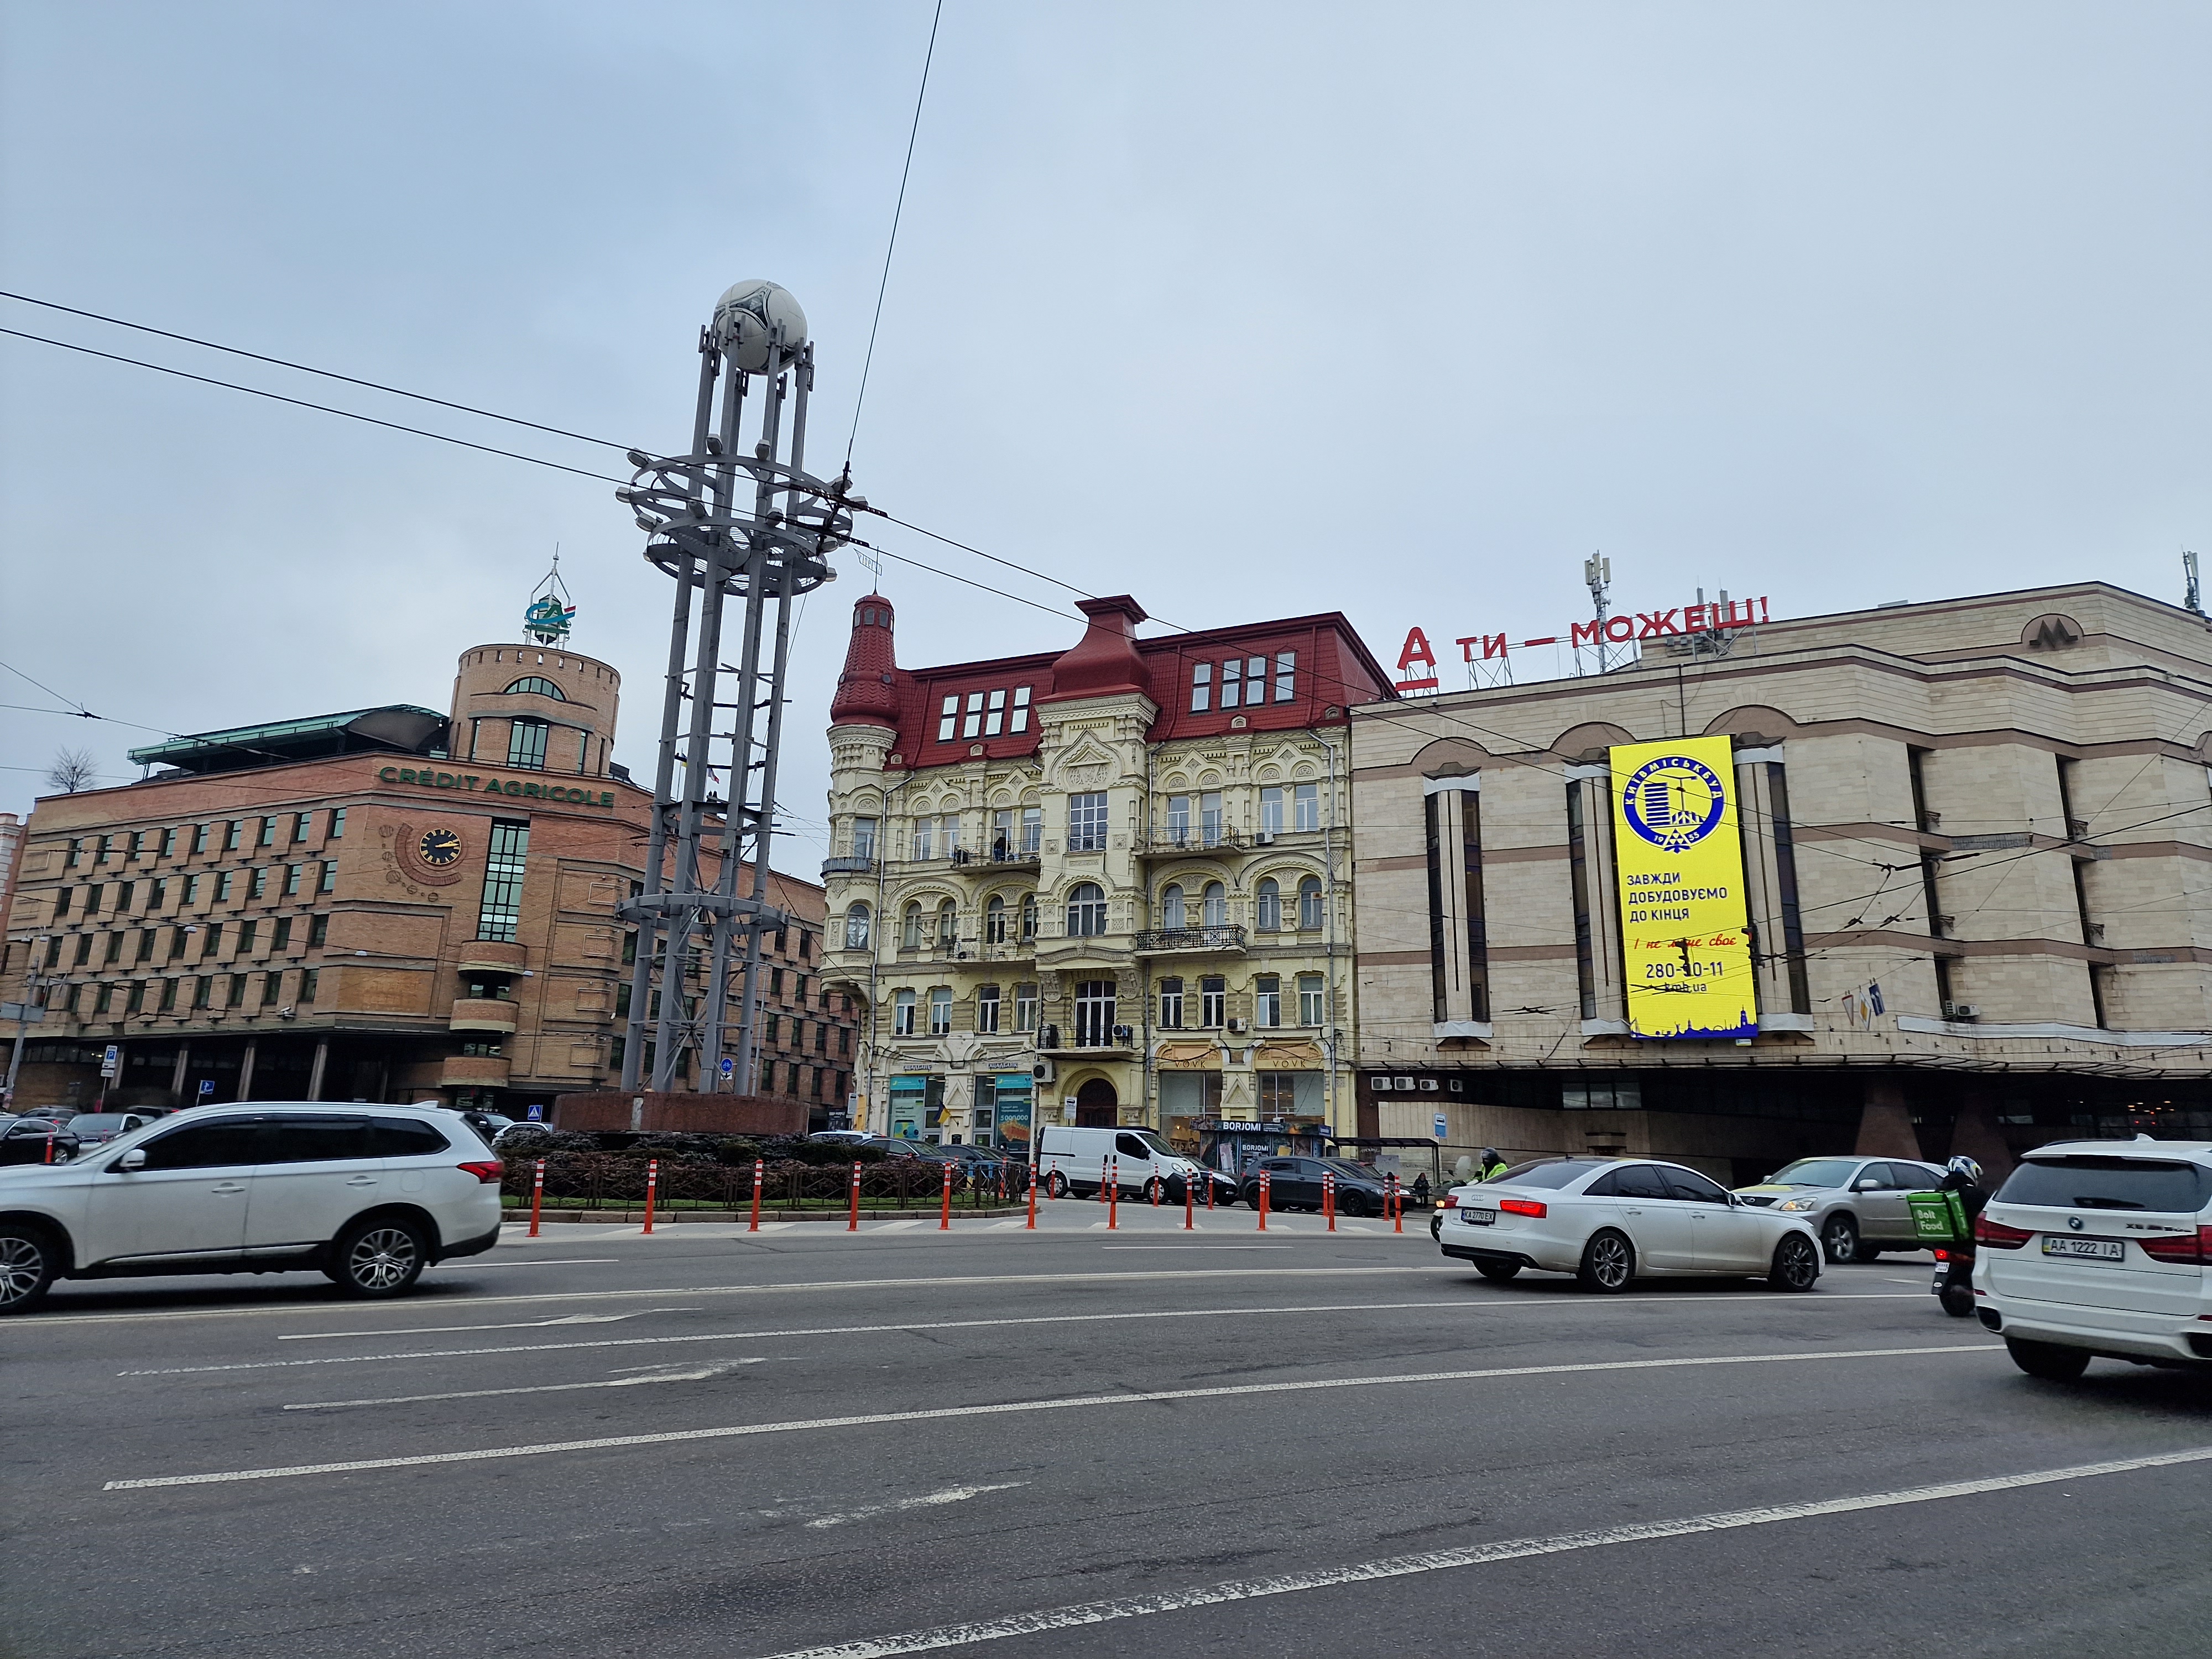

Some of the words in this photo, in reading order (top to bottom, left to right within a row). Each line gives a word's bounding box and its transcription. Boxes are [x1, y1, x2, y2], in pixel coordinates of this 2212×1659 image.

[1397, 627, 1436, 670] А
[379, 767, 479, 790] CRÉDIT
[484, 779, 614, 807] AGRICOLE
[1653, 834, 1663, 843] 19
[1688, 832, 1700, 841] 55
[1627, 872, 1681, 886] ЗАВЖДИ
[1628, 887, 1728, 905] ДОБУДОВУЄМО
[1630, 910, 1647, 923] ДО
[1651, 908, 1689, 921] КІНЦЯ
[1646, 940, 1662, 949] не
[1709, 933, 1738, 946] своє
[1175, 1060, 1206, 1068] VOVK
[1223, 1121, 1261, 1131] BORJOMI
[1917, 1209, 1936, 1219] Bolt
[1920, 1221, 1944, 1230] Food
[2051, 1240, 2067, 1251] AA
[2071, 1241, 2098, 1254] 1222
